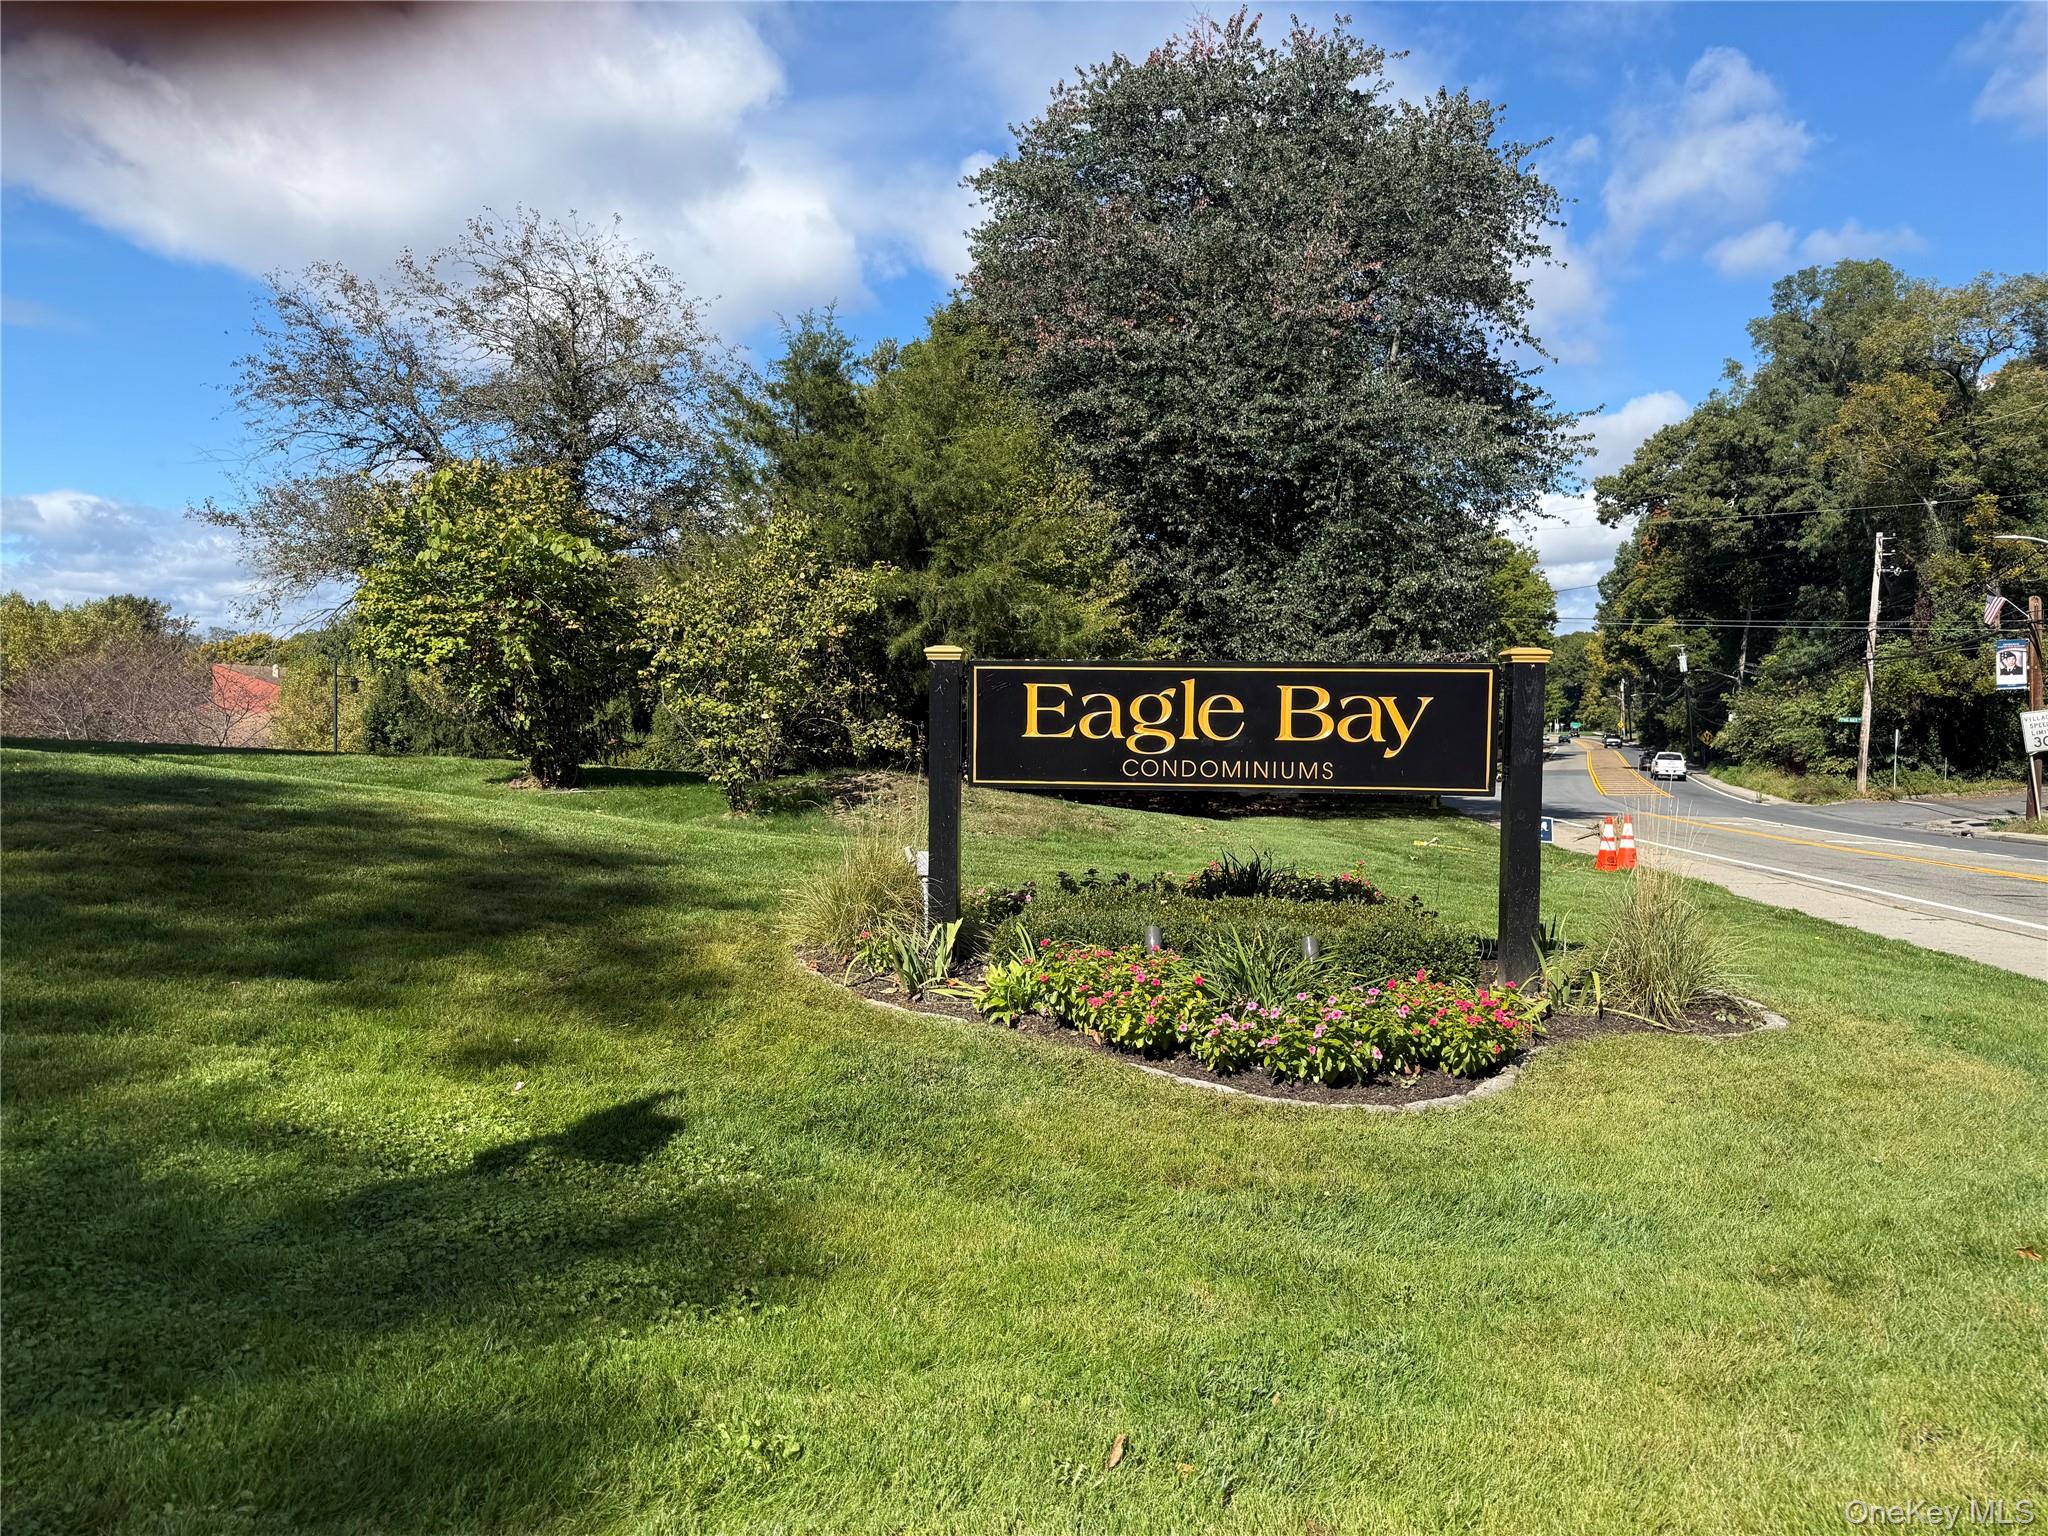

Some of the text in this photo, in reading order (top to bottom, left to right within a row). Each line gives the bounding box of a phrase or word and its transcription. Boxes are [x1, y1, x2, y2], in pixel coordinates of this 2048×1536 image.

[1022, 679, 1434, 759] Eagle Bay
[1122, 758, 1334, 780] CONDOMINIUMS
